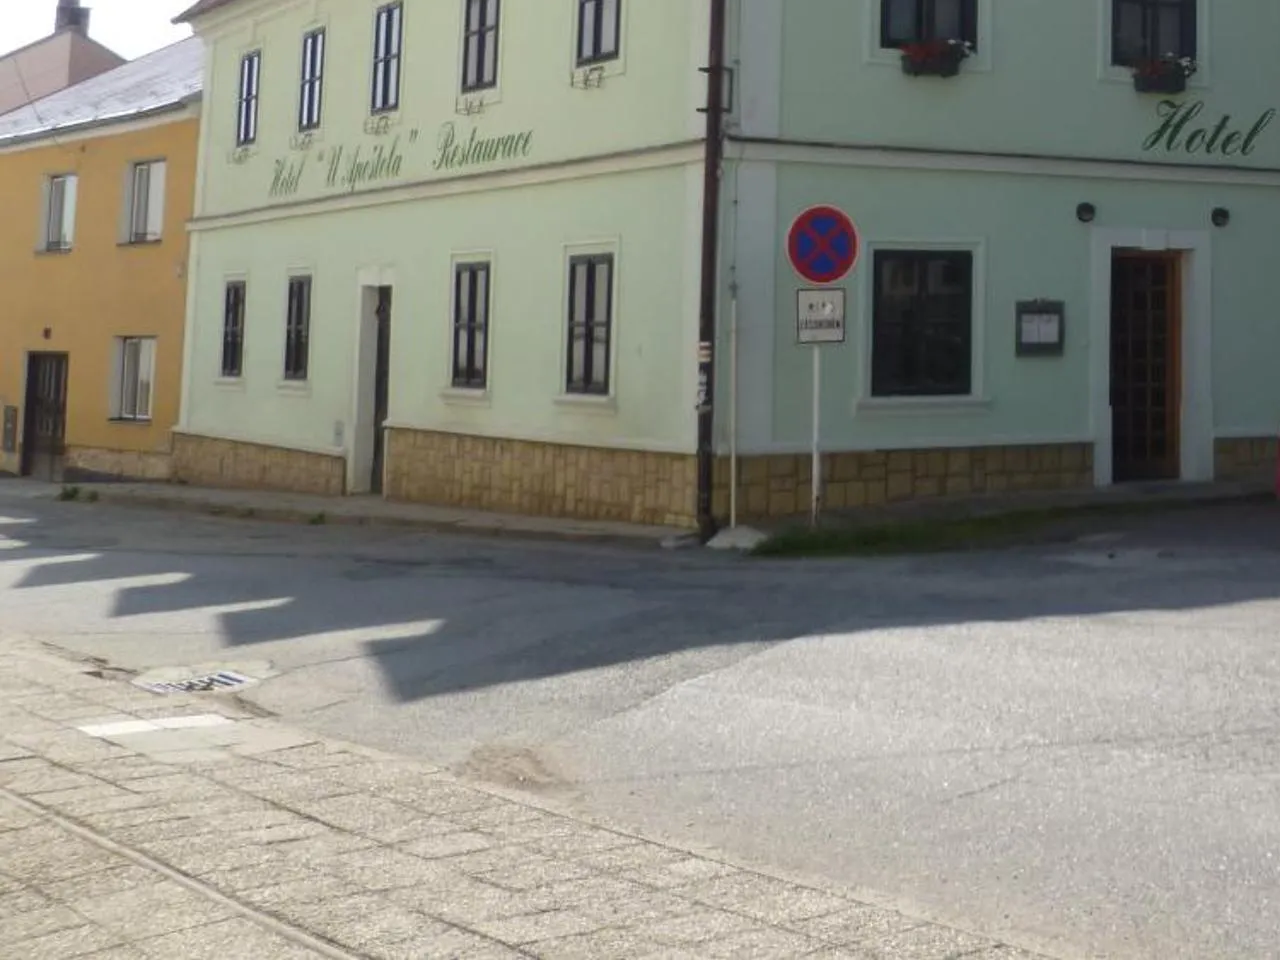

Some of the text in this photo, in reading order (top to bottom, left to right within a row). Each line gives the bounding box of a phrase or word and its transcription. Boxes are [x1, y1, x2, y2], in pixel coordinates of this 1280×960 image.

[268, 155, 306, 197] Hotel
[432, 120, 534, 172] Restaurace
[1142, 100, 1277, 156] Hotel
